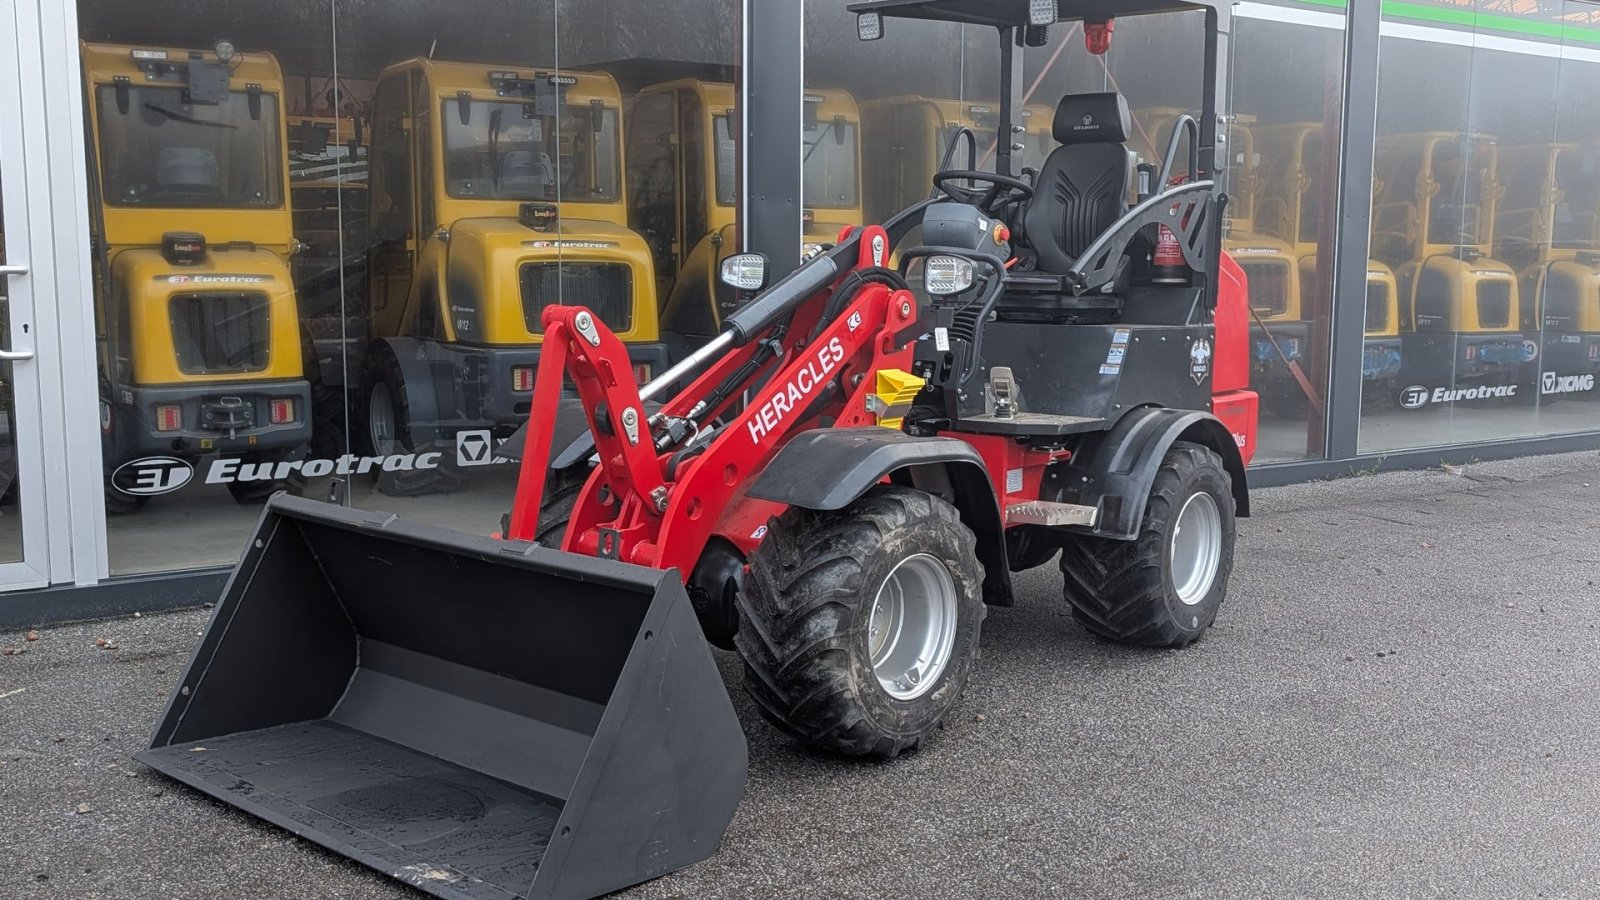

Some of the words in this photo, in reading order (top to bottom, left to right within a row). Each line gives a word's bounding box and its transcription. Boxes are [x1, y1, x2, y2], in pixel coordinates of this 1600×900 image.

[554, 241, 610, 249] Eurotrac
[193, 275, 262, 284] Eurotrac
[849, 312, 861, 329] CE
[747, 336, 844, 445] HERACLES
[1554, 374, 1594, 393] XCMG
[1431, 384, 1518, 403] Eurotrac
[204, 448, 443, 485] Eurotrac
